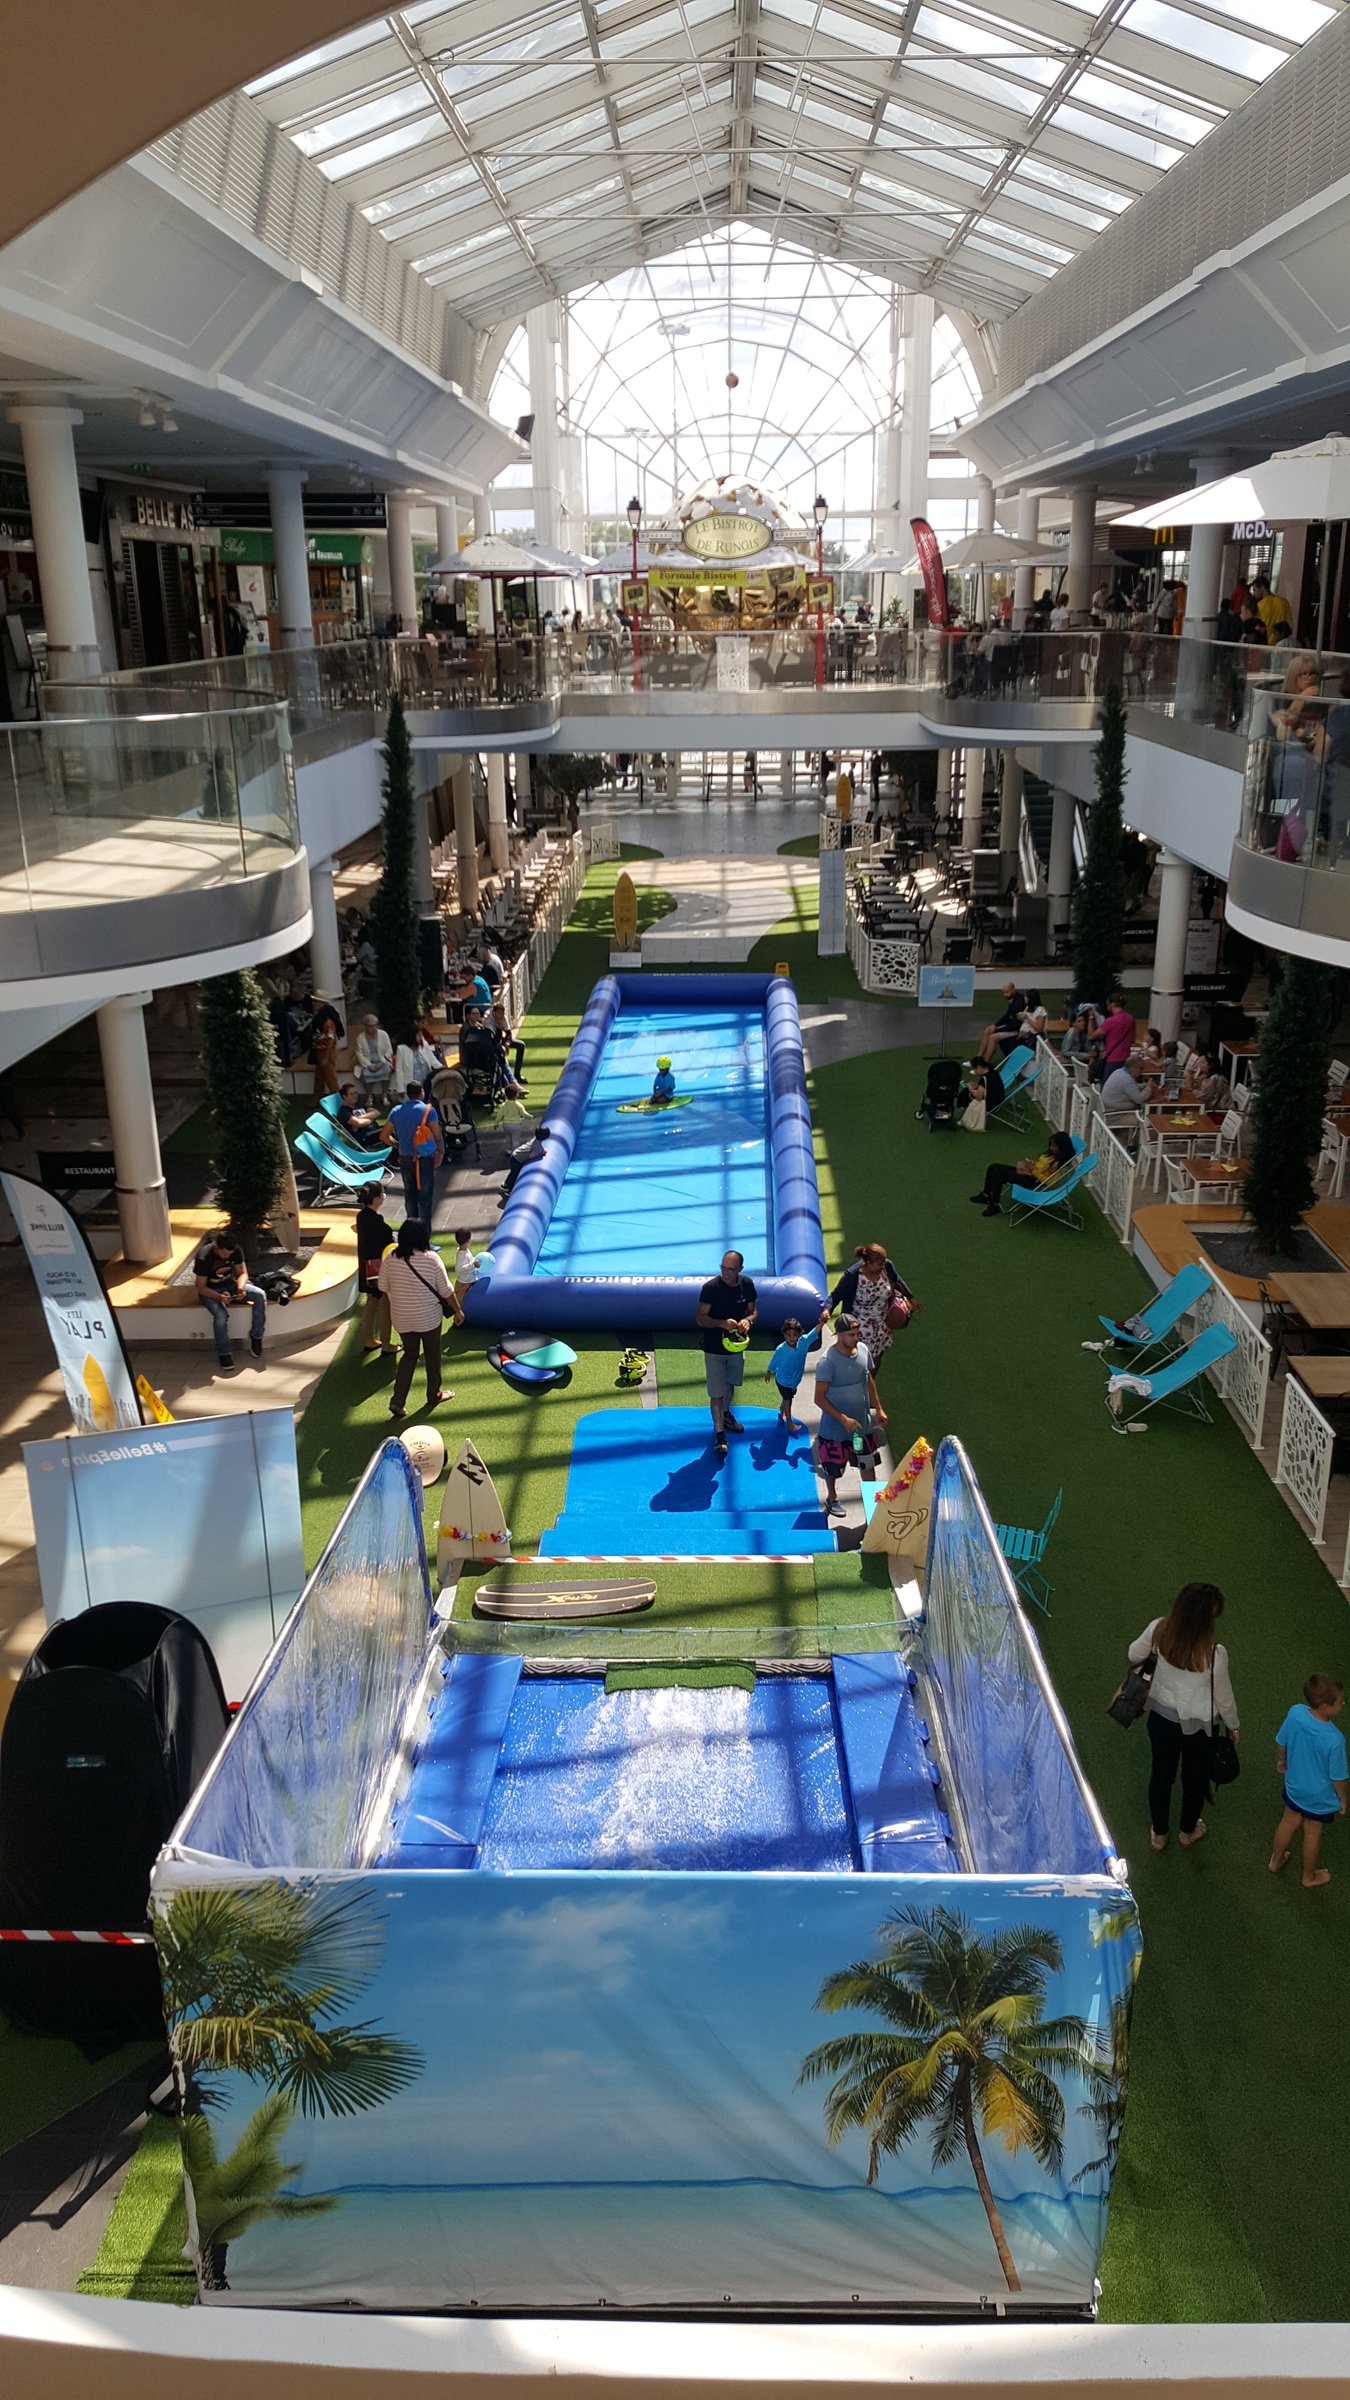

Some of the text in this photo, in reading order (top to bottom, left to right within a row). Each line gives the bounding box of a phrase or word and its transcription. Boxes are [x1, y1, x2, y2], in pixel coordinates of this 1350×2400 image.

[137, 496, 176, 528] BELLE
[695, 517, 762, 533] LE BISTROT
[696, 538, 760, 553] DE RUNGIS
[659, 570, 701, 580] Formule
[703, 570, 737, 580] Bistrot
[64, 1167, 115, 1175] RESTAURANT
